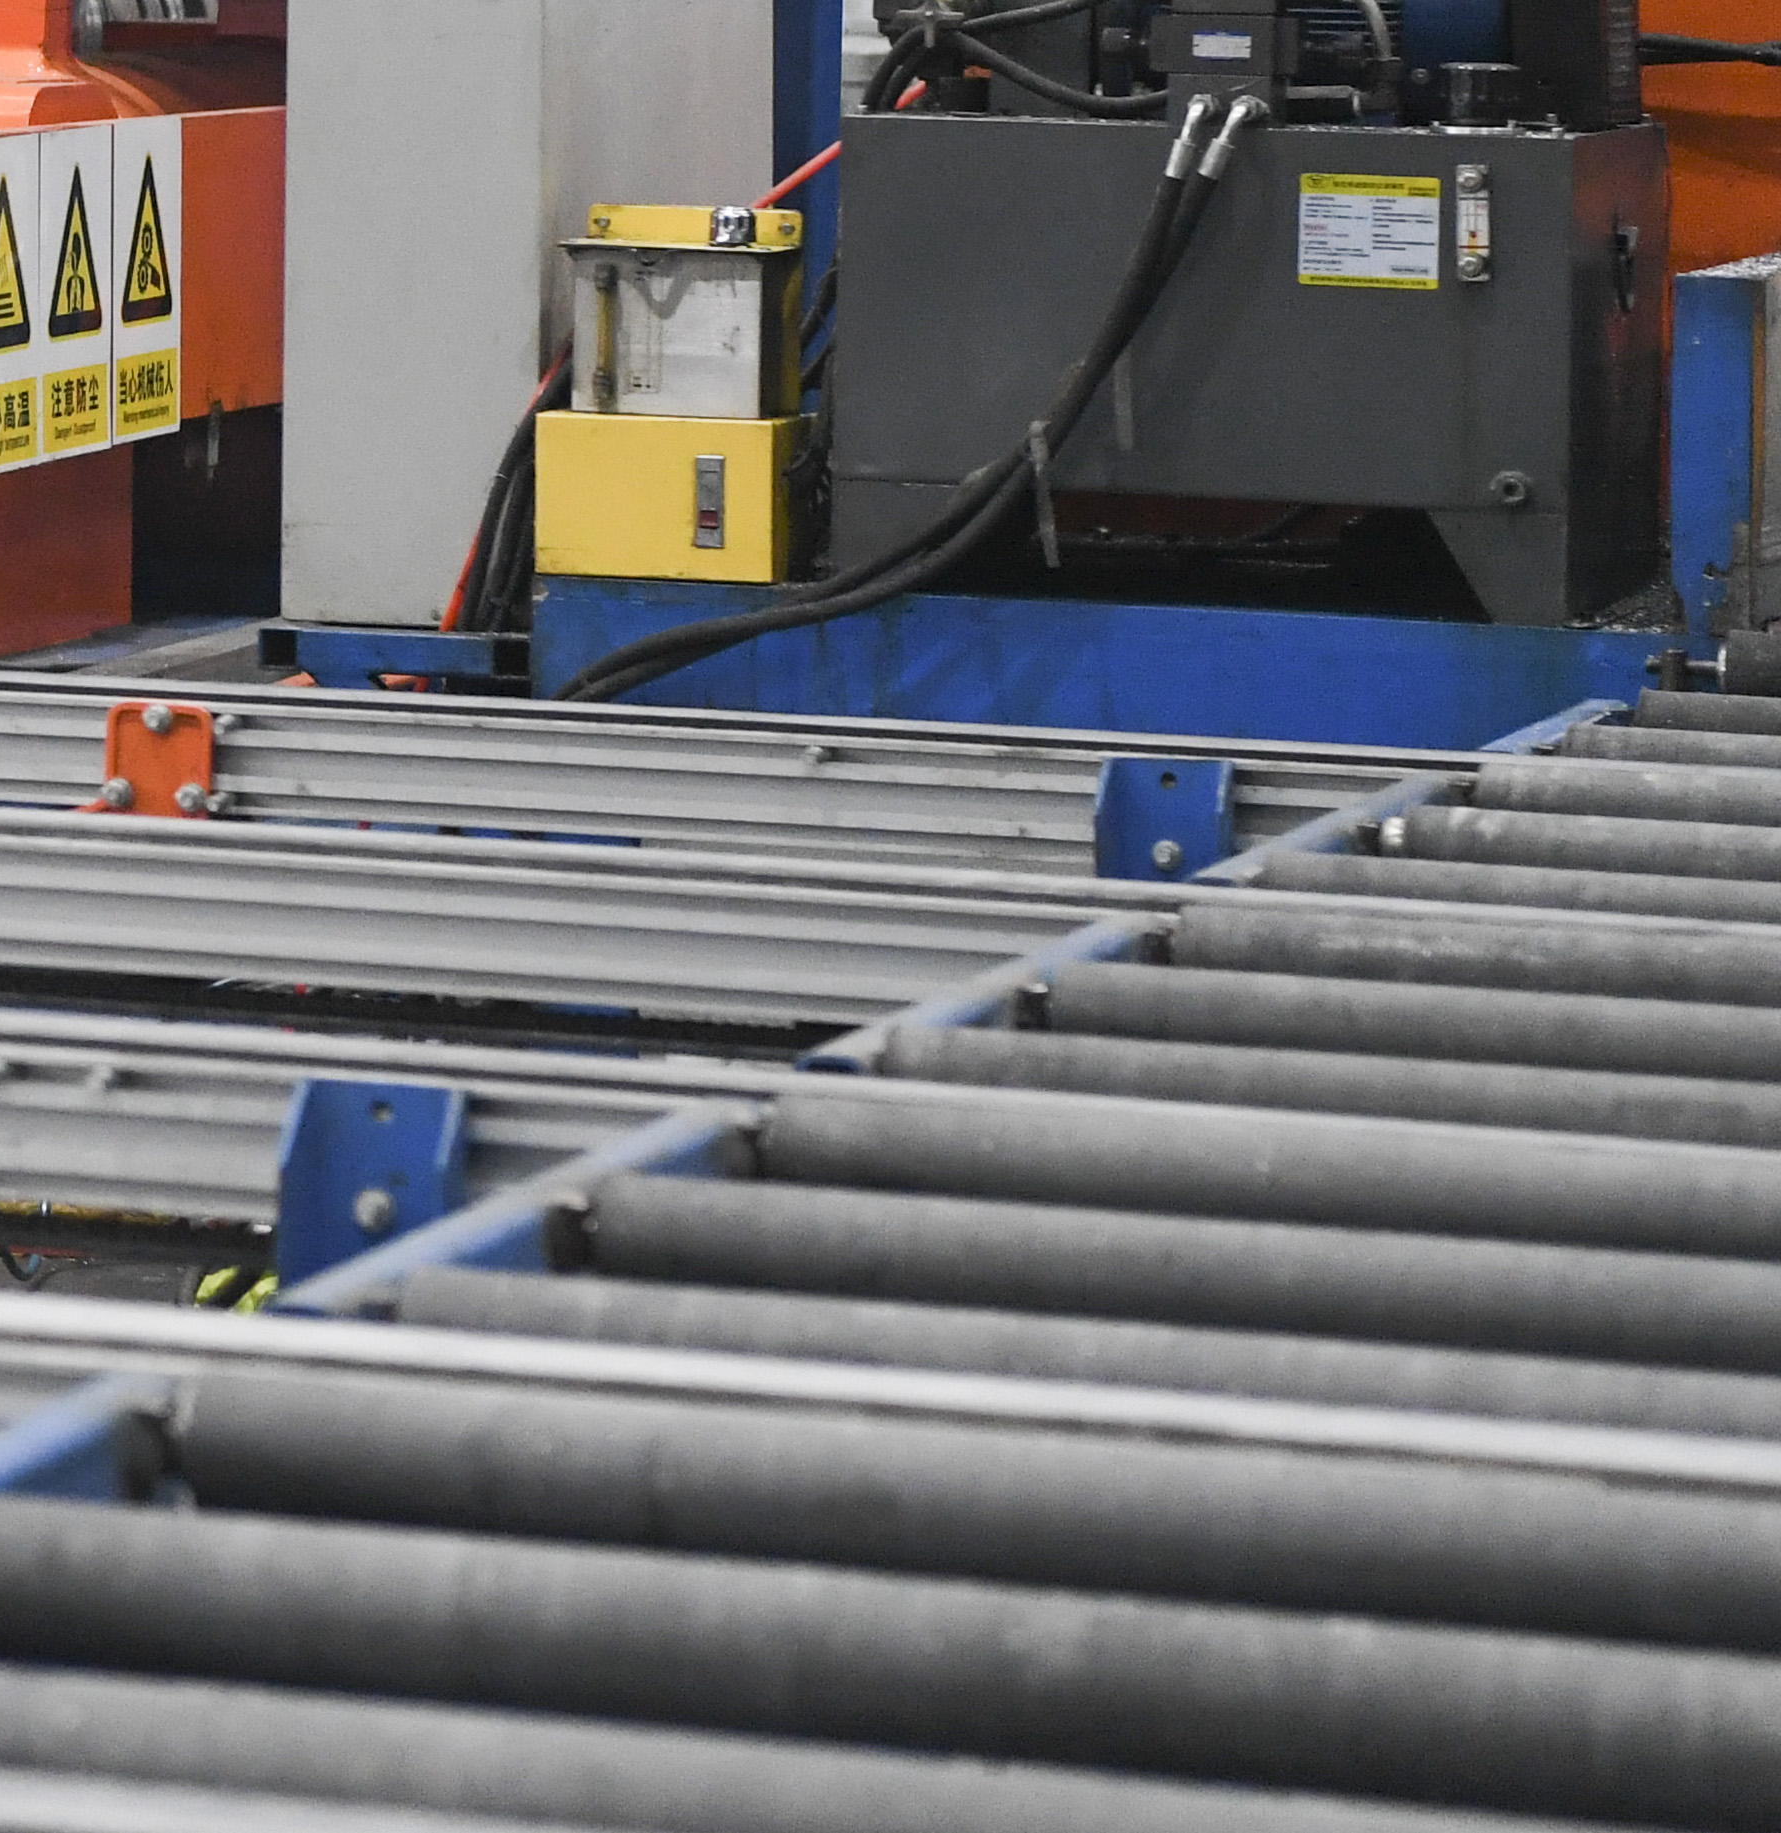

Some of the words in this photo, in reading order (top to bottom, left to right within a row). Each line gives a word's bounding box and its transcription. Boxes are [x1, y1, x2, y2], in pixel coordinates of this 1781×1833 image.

[51, 374, 99, 418] 注意防尘
[120, 359, 173, 404] 当心机械伤人
